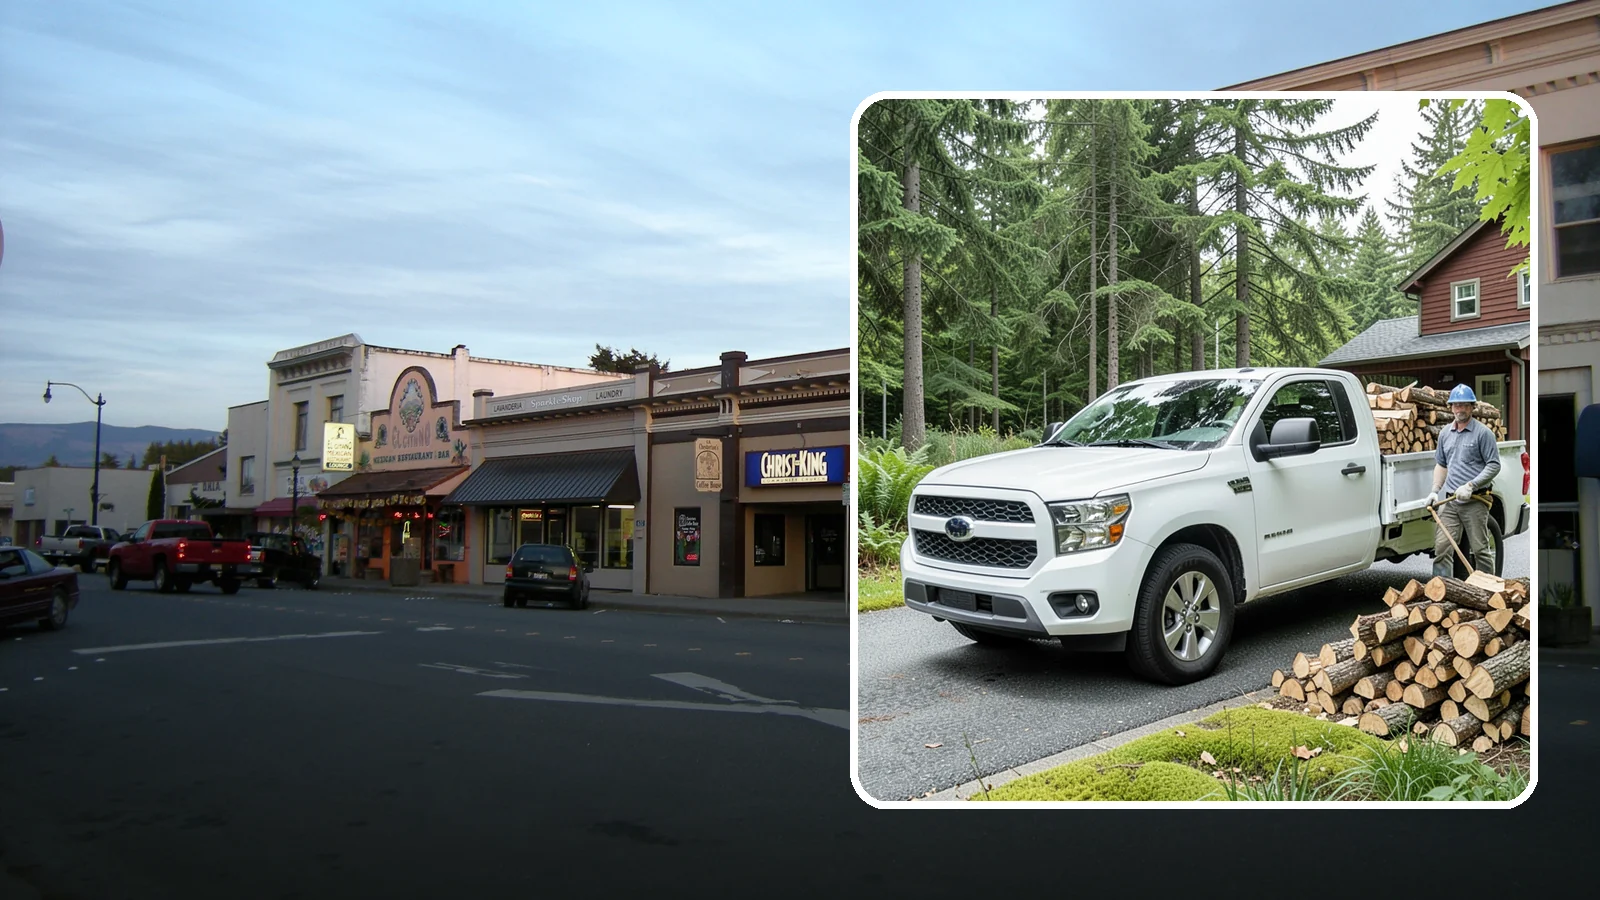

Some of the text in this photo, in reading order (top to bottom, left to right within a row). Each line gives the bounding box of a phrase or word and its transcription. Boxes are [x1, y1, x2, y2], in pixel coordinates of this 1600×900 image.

[595, 389, 623, 400] LAUNDRY
[493, 402, 522, 412] LAVANDERIA
[374, 450, 450, 464] MEXICAN RESTAURANT BAR
[761, 450, 827, 477] CHRIST KING
